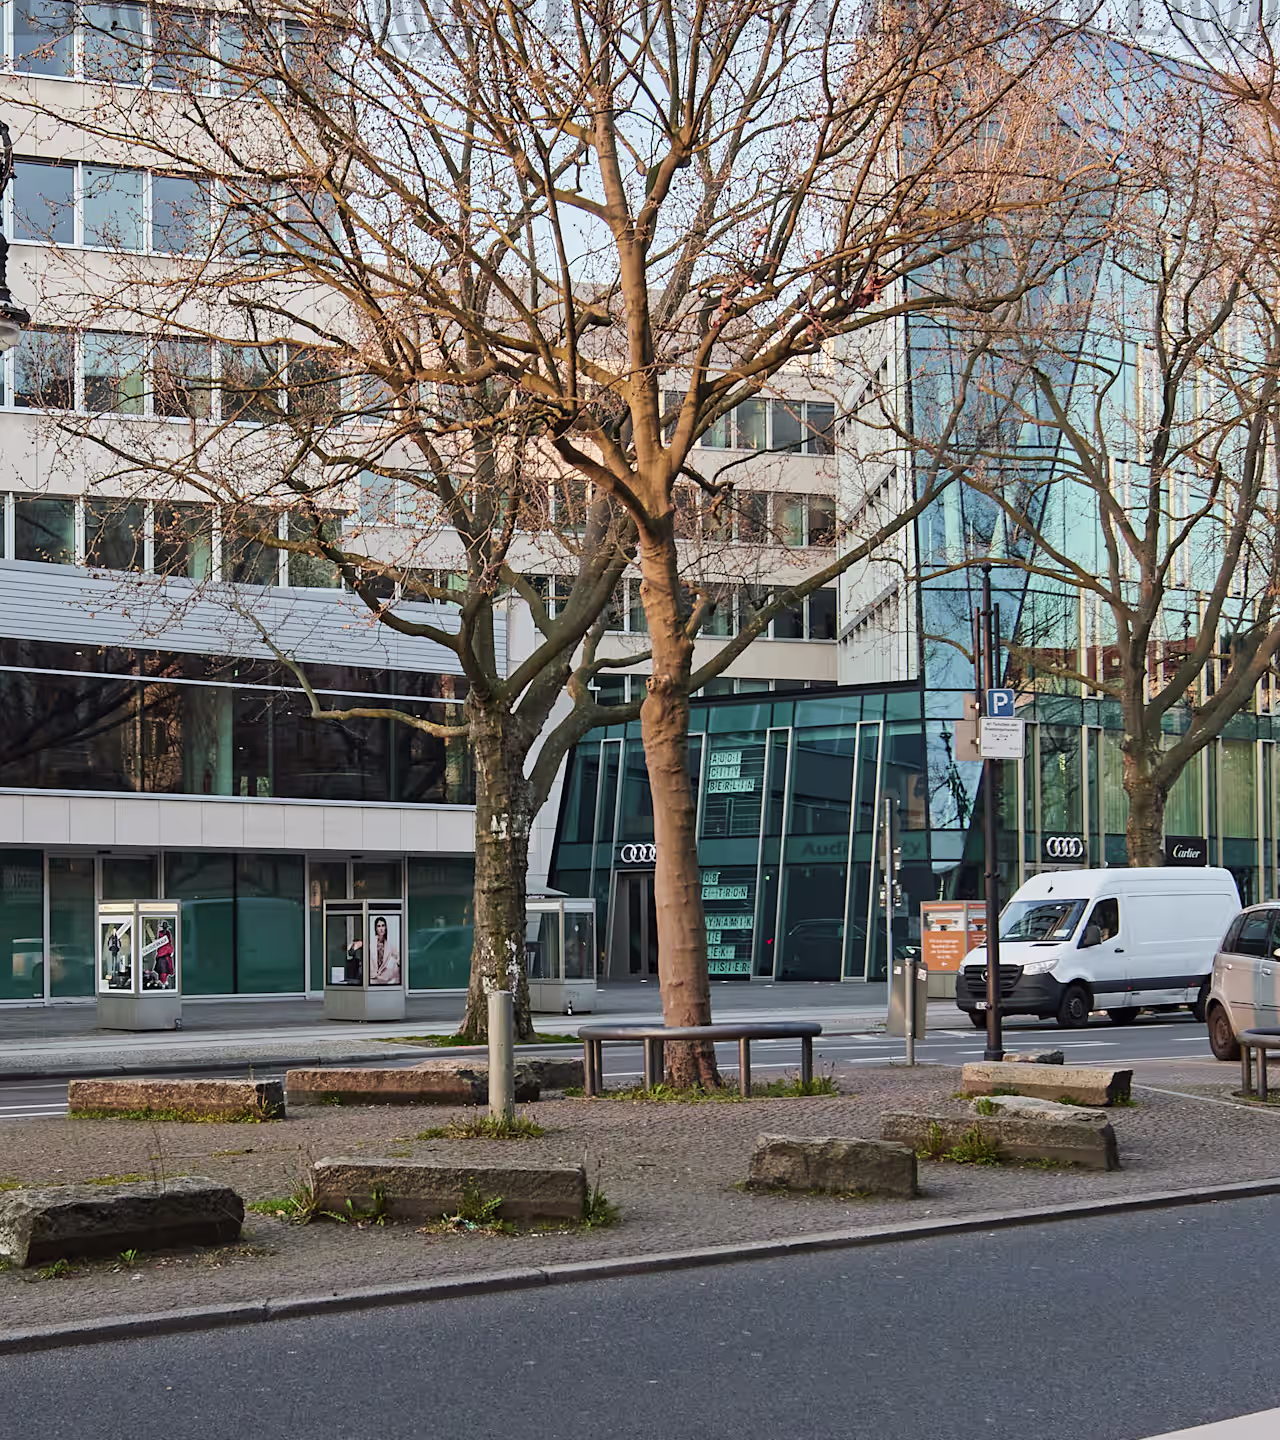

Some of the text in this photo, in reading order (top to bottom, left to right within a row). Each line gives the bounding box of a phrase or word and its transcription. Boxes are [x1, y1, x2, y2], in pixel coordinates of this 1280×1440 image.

[993, 692, 1008, 714] P
[712, 752, 739, 763] AUDI
[711, 766, 739, 777] CITY
[710, 780, 753, 791] BERLIN
[1173, 844, 1201, 858] Cartier
